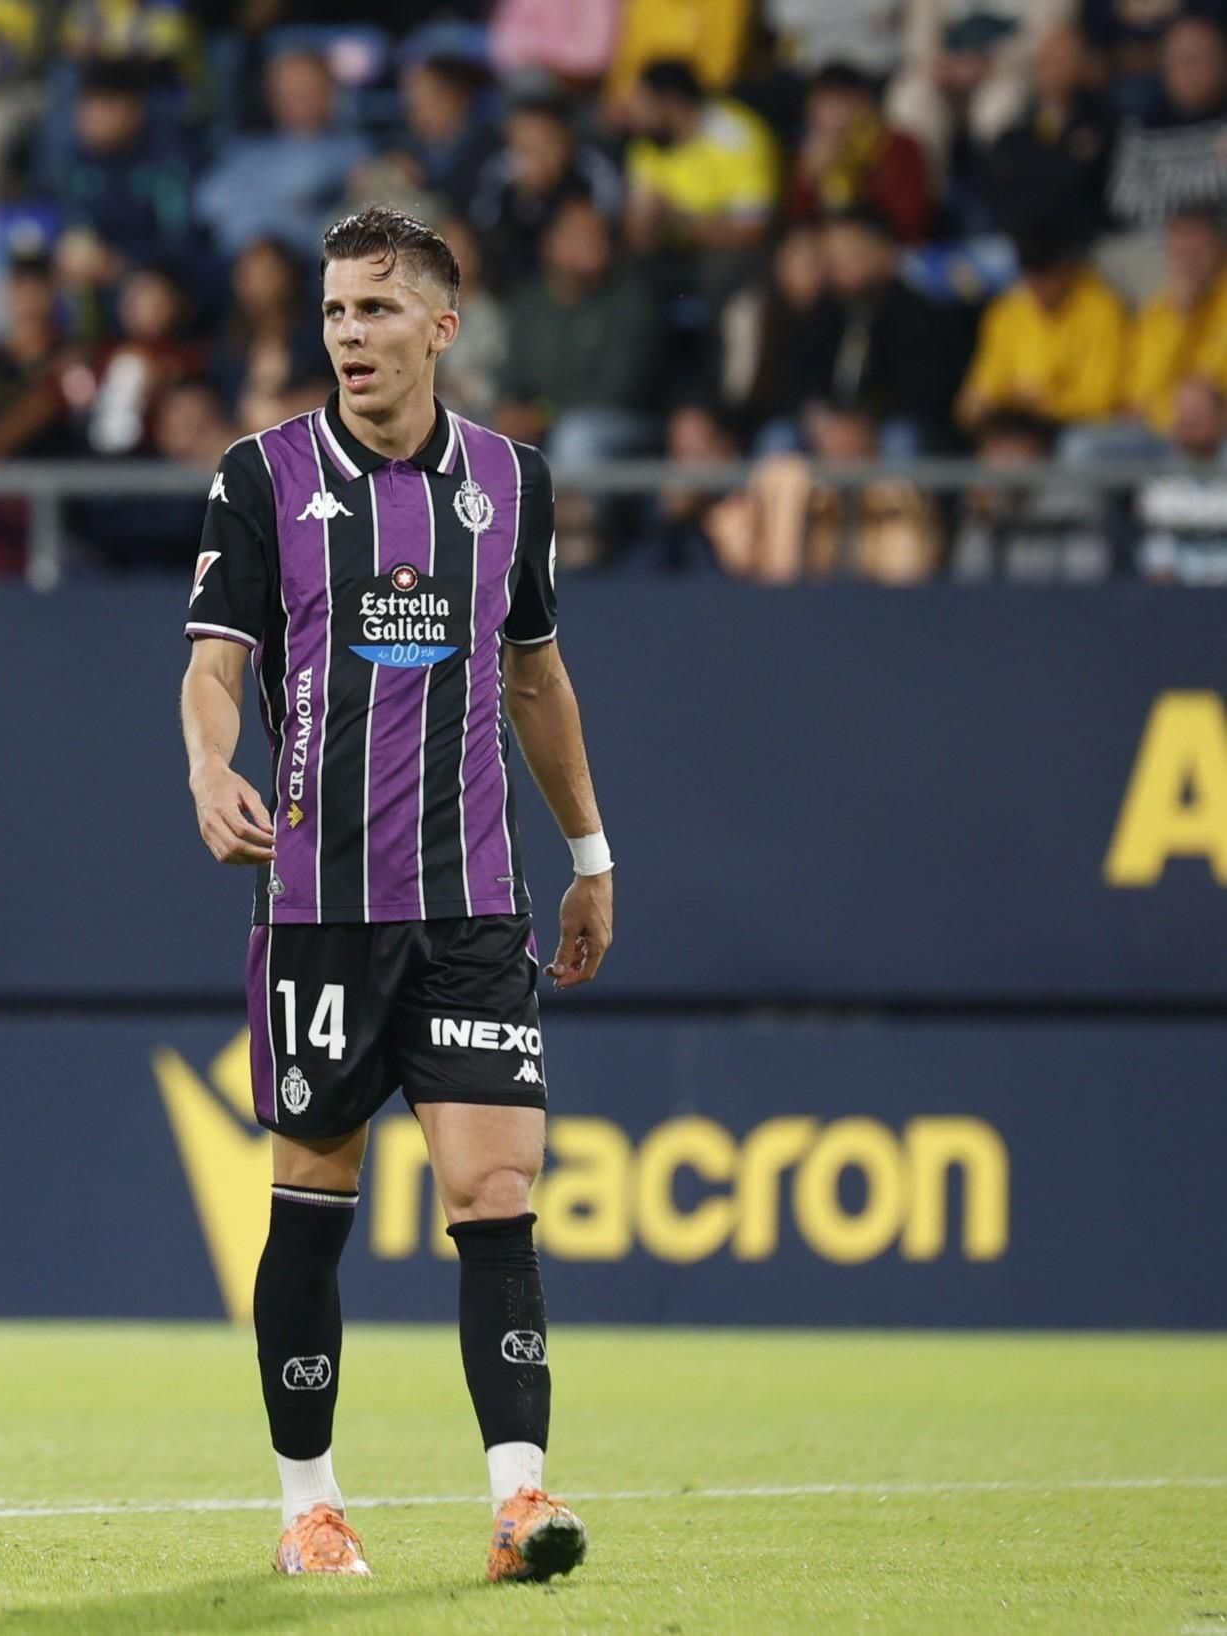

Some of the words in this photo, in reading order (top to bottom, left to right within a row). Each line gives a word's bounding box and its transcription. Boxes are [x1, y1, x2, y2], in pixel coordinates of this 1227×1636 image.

[359, 592, 450, 616] Estrella
[363, 616, 446, 641] Galicia
[292, 666, 313, 767] ZAMORA
[1103, 690, 1227, 887] A
[275, 979, 346, 1061] 14
[430, 1018, 541, 1056] INEXO
